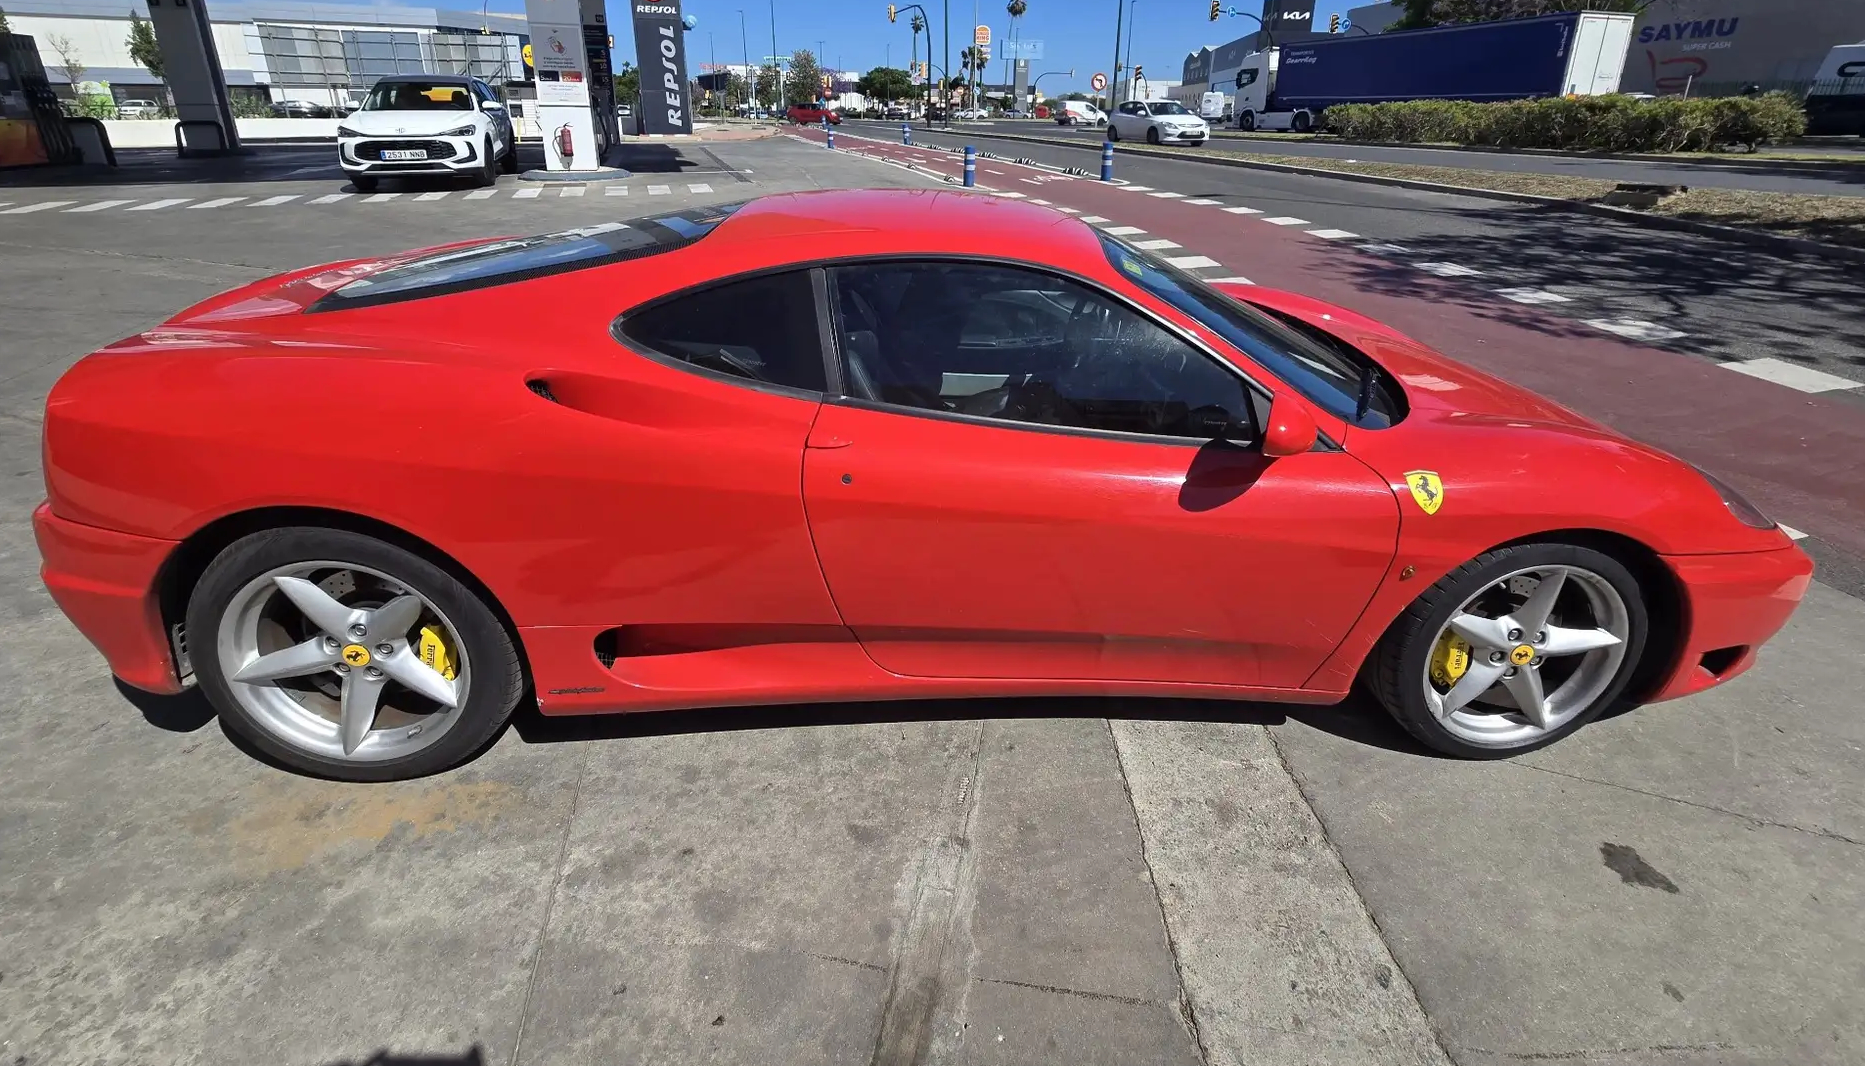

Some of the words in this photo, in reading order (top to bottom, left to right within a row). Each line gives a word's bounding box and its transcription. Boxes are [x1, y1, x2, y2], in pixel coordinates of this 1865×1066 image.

[636, 5, 677, 14] REPSOL
[1282, 11, 1310, 20] KIA
[1638, 17, 1739, 43] SAYMU
[1682, 43, 1707, 51] SUPER
[1708, 41, 1731, 50] CASH
[659, 25, 682, 127] REPSOL
